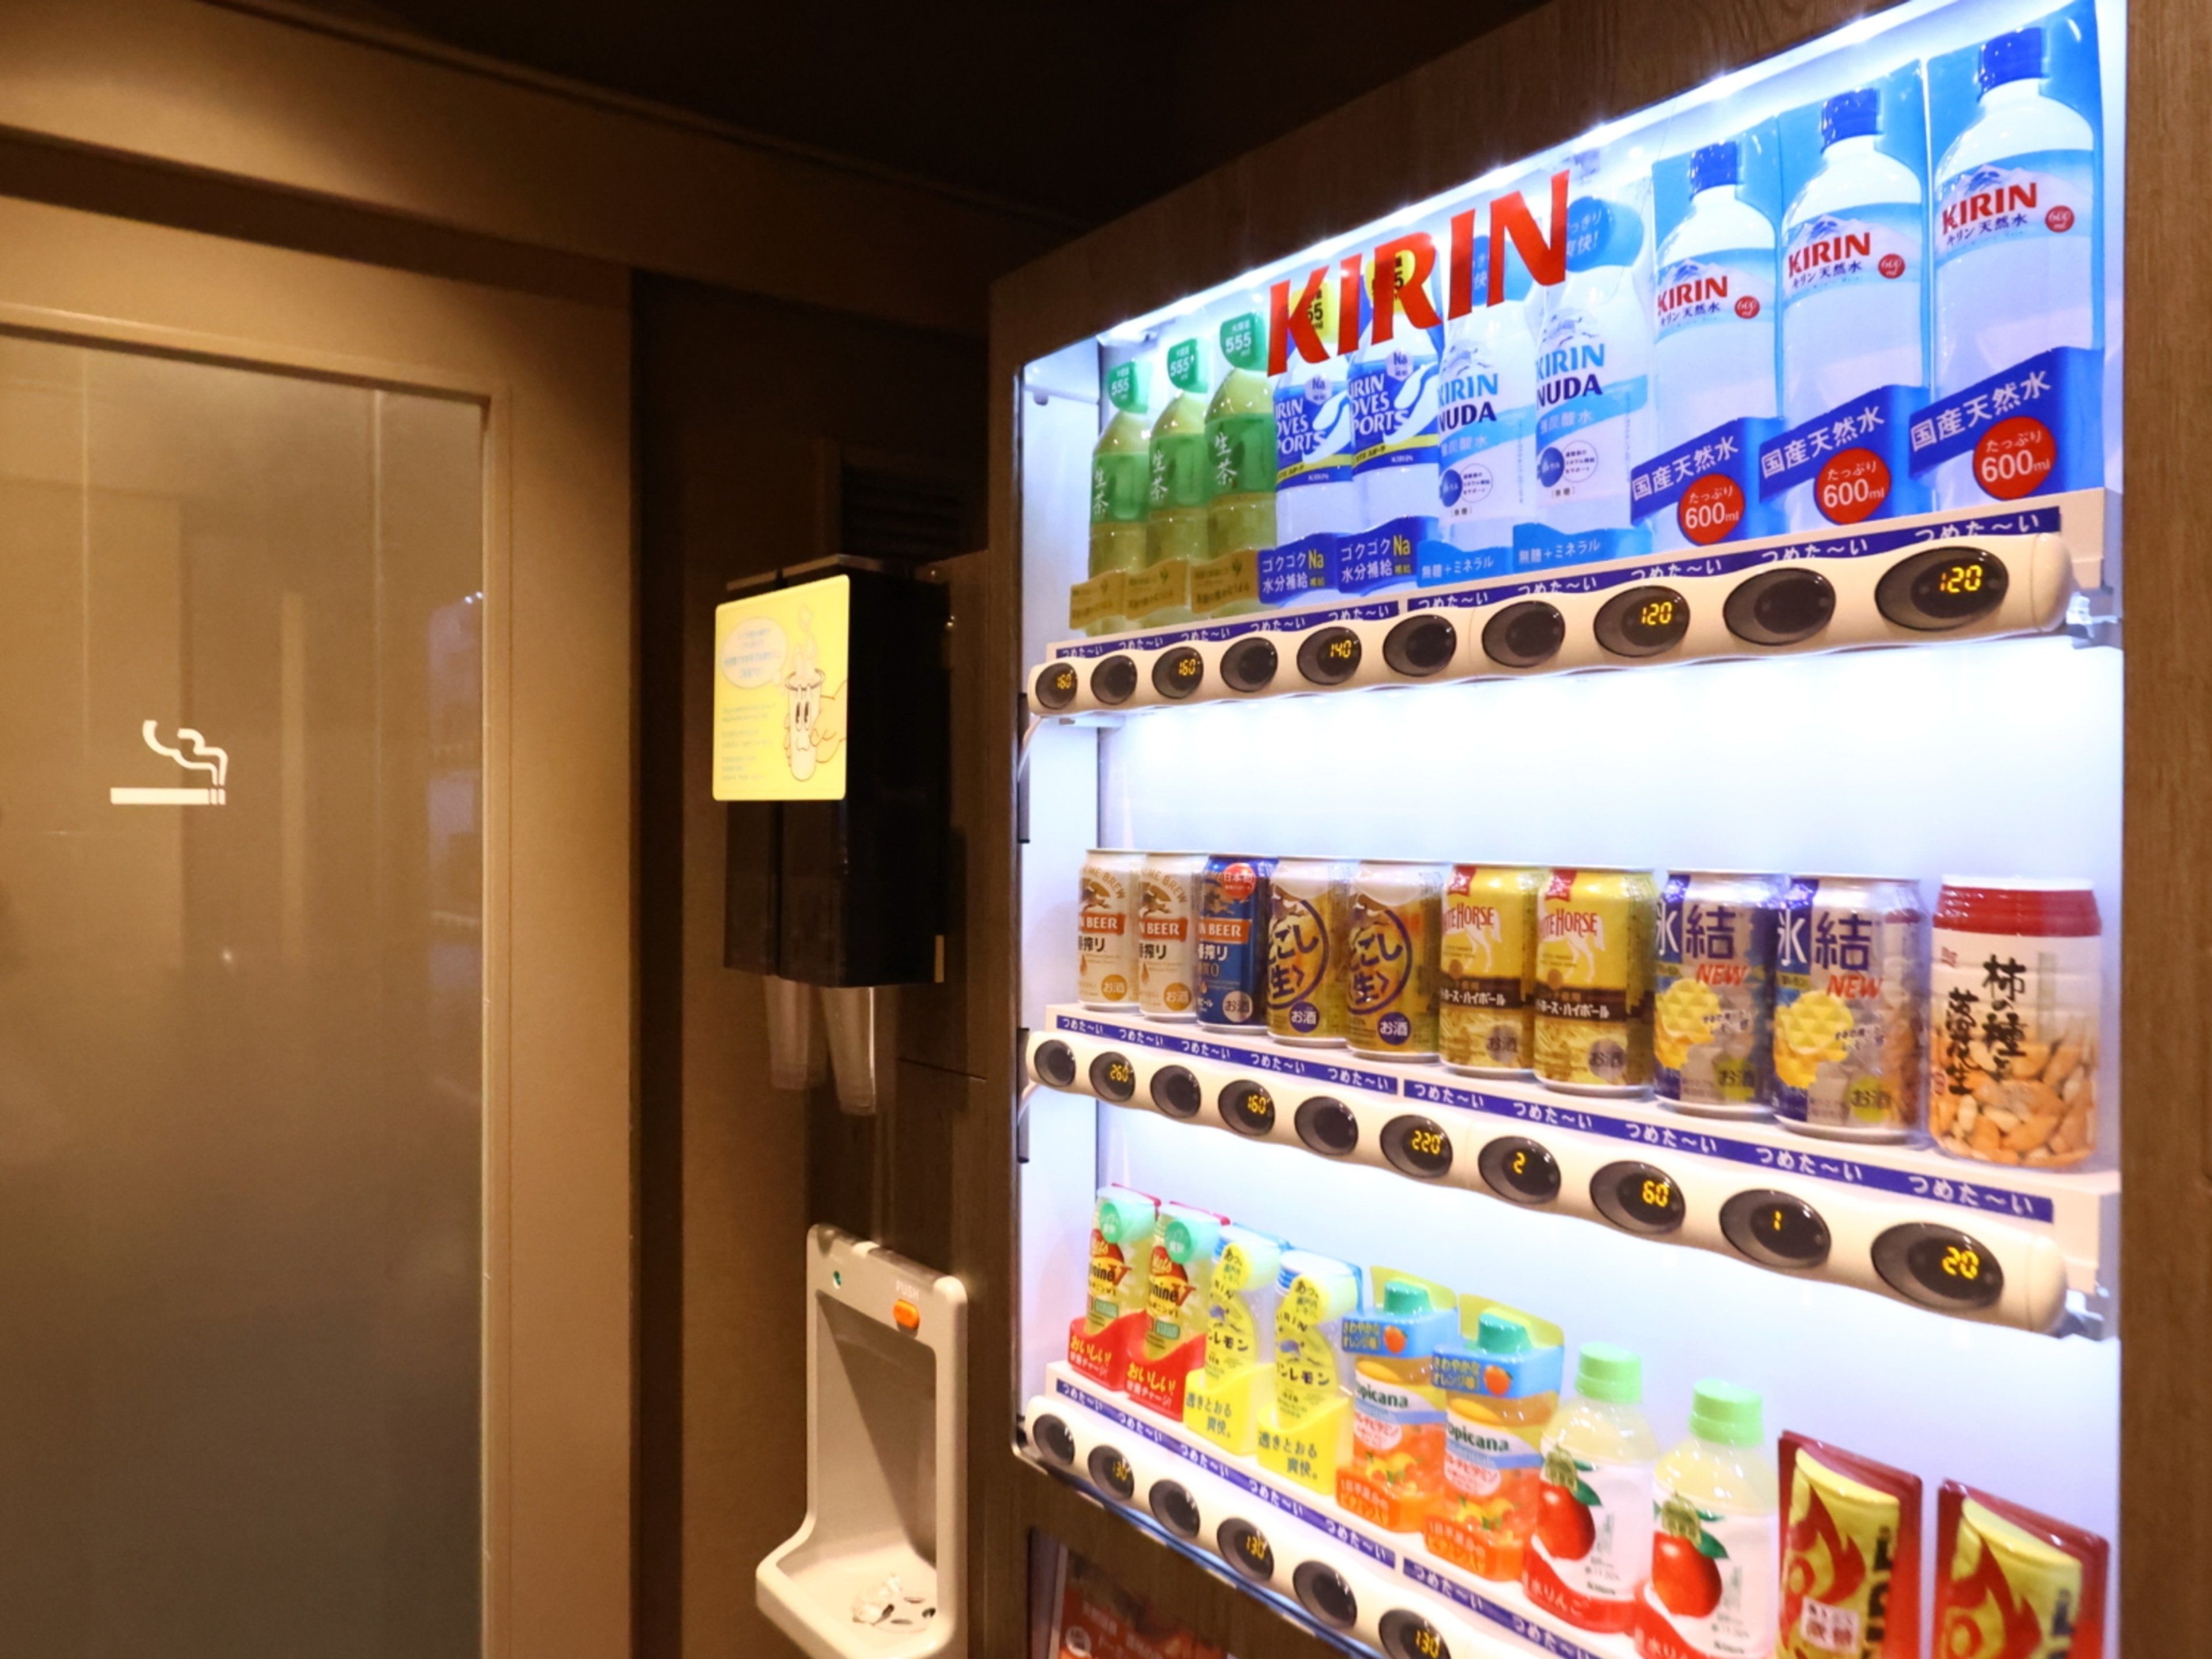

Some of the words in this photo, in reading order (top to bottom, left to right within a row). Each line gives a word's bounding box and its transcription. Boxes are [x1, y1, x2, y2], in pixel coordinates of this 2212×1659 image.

[1942, 183, 2036, 235] KIRIN
[1789, 232, 1870, 278] KIRIN
[1268, 169, 1570, 377] KIRIN
[1658, 276, 1727, 316] KIRIN
[1225, 332, 1251, 353] 555
[1170, 357, 1190, 376] 555
[1536, 343, 1605, 381] KIRIN
[1111, 378, 1130, 396] 555
[1349, 373, 1385, 399] IRIN
[1536, 374, 1603, 410] NUDA
[1275, 397, 1304, 418] IRIN
[1353, 391, 1390, 419] OVES
[1911, 369, 2051, 452] 国産天然水
[1275, 414, 1309, 437] OVES
[1354, 410, 1409, 435] PORTS
[1277, 430, 1326, 455] PORTS
[1761, 406, 1885, 479] 国産天然水
[1985, 429, 2042, 454] たっぷり
[1214, 431, 1237, 485] 生茶
[1632, 436, 1738, 502] 国産天然水
[1827, 460, 1877, 482] たっぷり
[1980, 448, 2051, 483] 600ml
[1152, 452, 1168, 501] 生茶
[1093, 465, 1109, 515] 生茶
[1688, 483, 1734, 505] たっぷり
[1823, 478, 1884, 509] 600ml
[1684, 501, 1739, 529] 600ml
[1262, 552, 1306, 573] ゴクゴク
[1308, 548, 1324, 569] Na
[1341, 538, 1391, 562] ゴクゴク
[1393, 534, 1411, 556] Na
[1262, 571, 1308, 593] 水分補給
[1341, 559, 1392, 583] 水分補給
[1940, 565, 1982, 593] 120
[1641, 601, 1673, 625] 120
[1330, 640, 1352, 658] 140
[1179, 658, 1196, 676] 160
[1086, 916, 1118, 929] BEER
[1146, 922, 1180, 935] BEER
[1457, 902, 1495, 930] HORSE
[1556, 908, 1598, 938] HORSE
[1656, 897, 1737, 960] 氷結
[1209, 924, 1241, 937] BEER
[1777, 908, 1872, 971] 氷結
[1695, 964, 1748, 986] NEW
[1827, 975, 1883, 1001] NEW
[1291, 1010, 1317, 1025] お酒
[1380, 1021, 1408, 1037] お酒
[1411, 1130, 1441, 1155] 220
[1941, 1245, 1980, 1280] 20
[896, 1279, 919, 1301] PUSH
[1356, 1382, 1408, 1409] opicana
[1447, 1421, 1509, 1452] opicana
